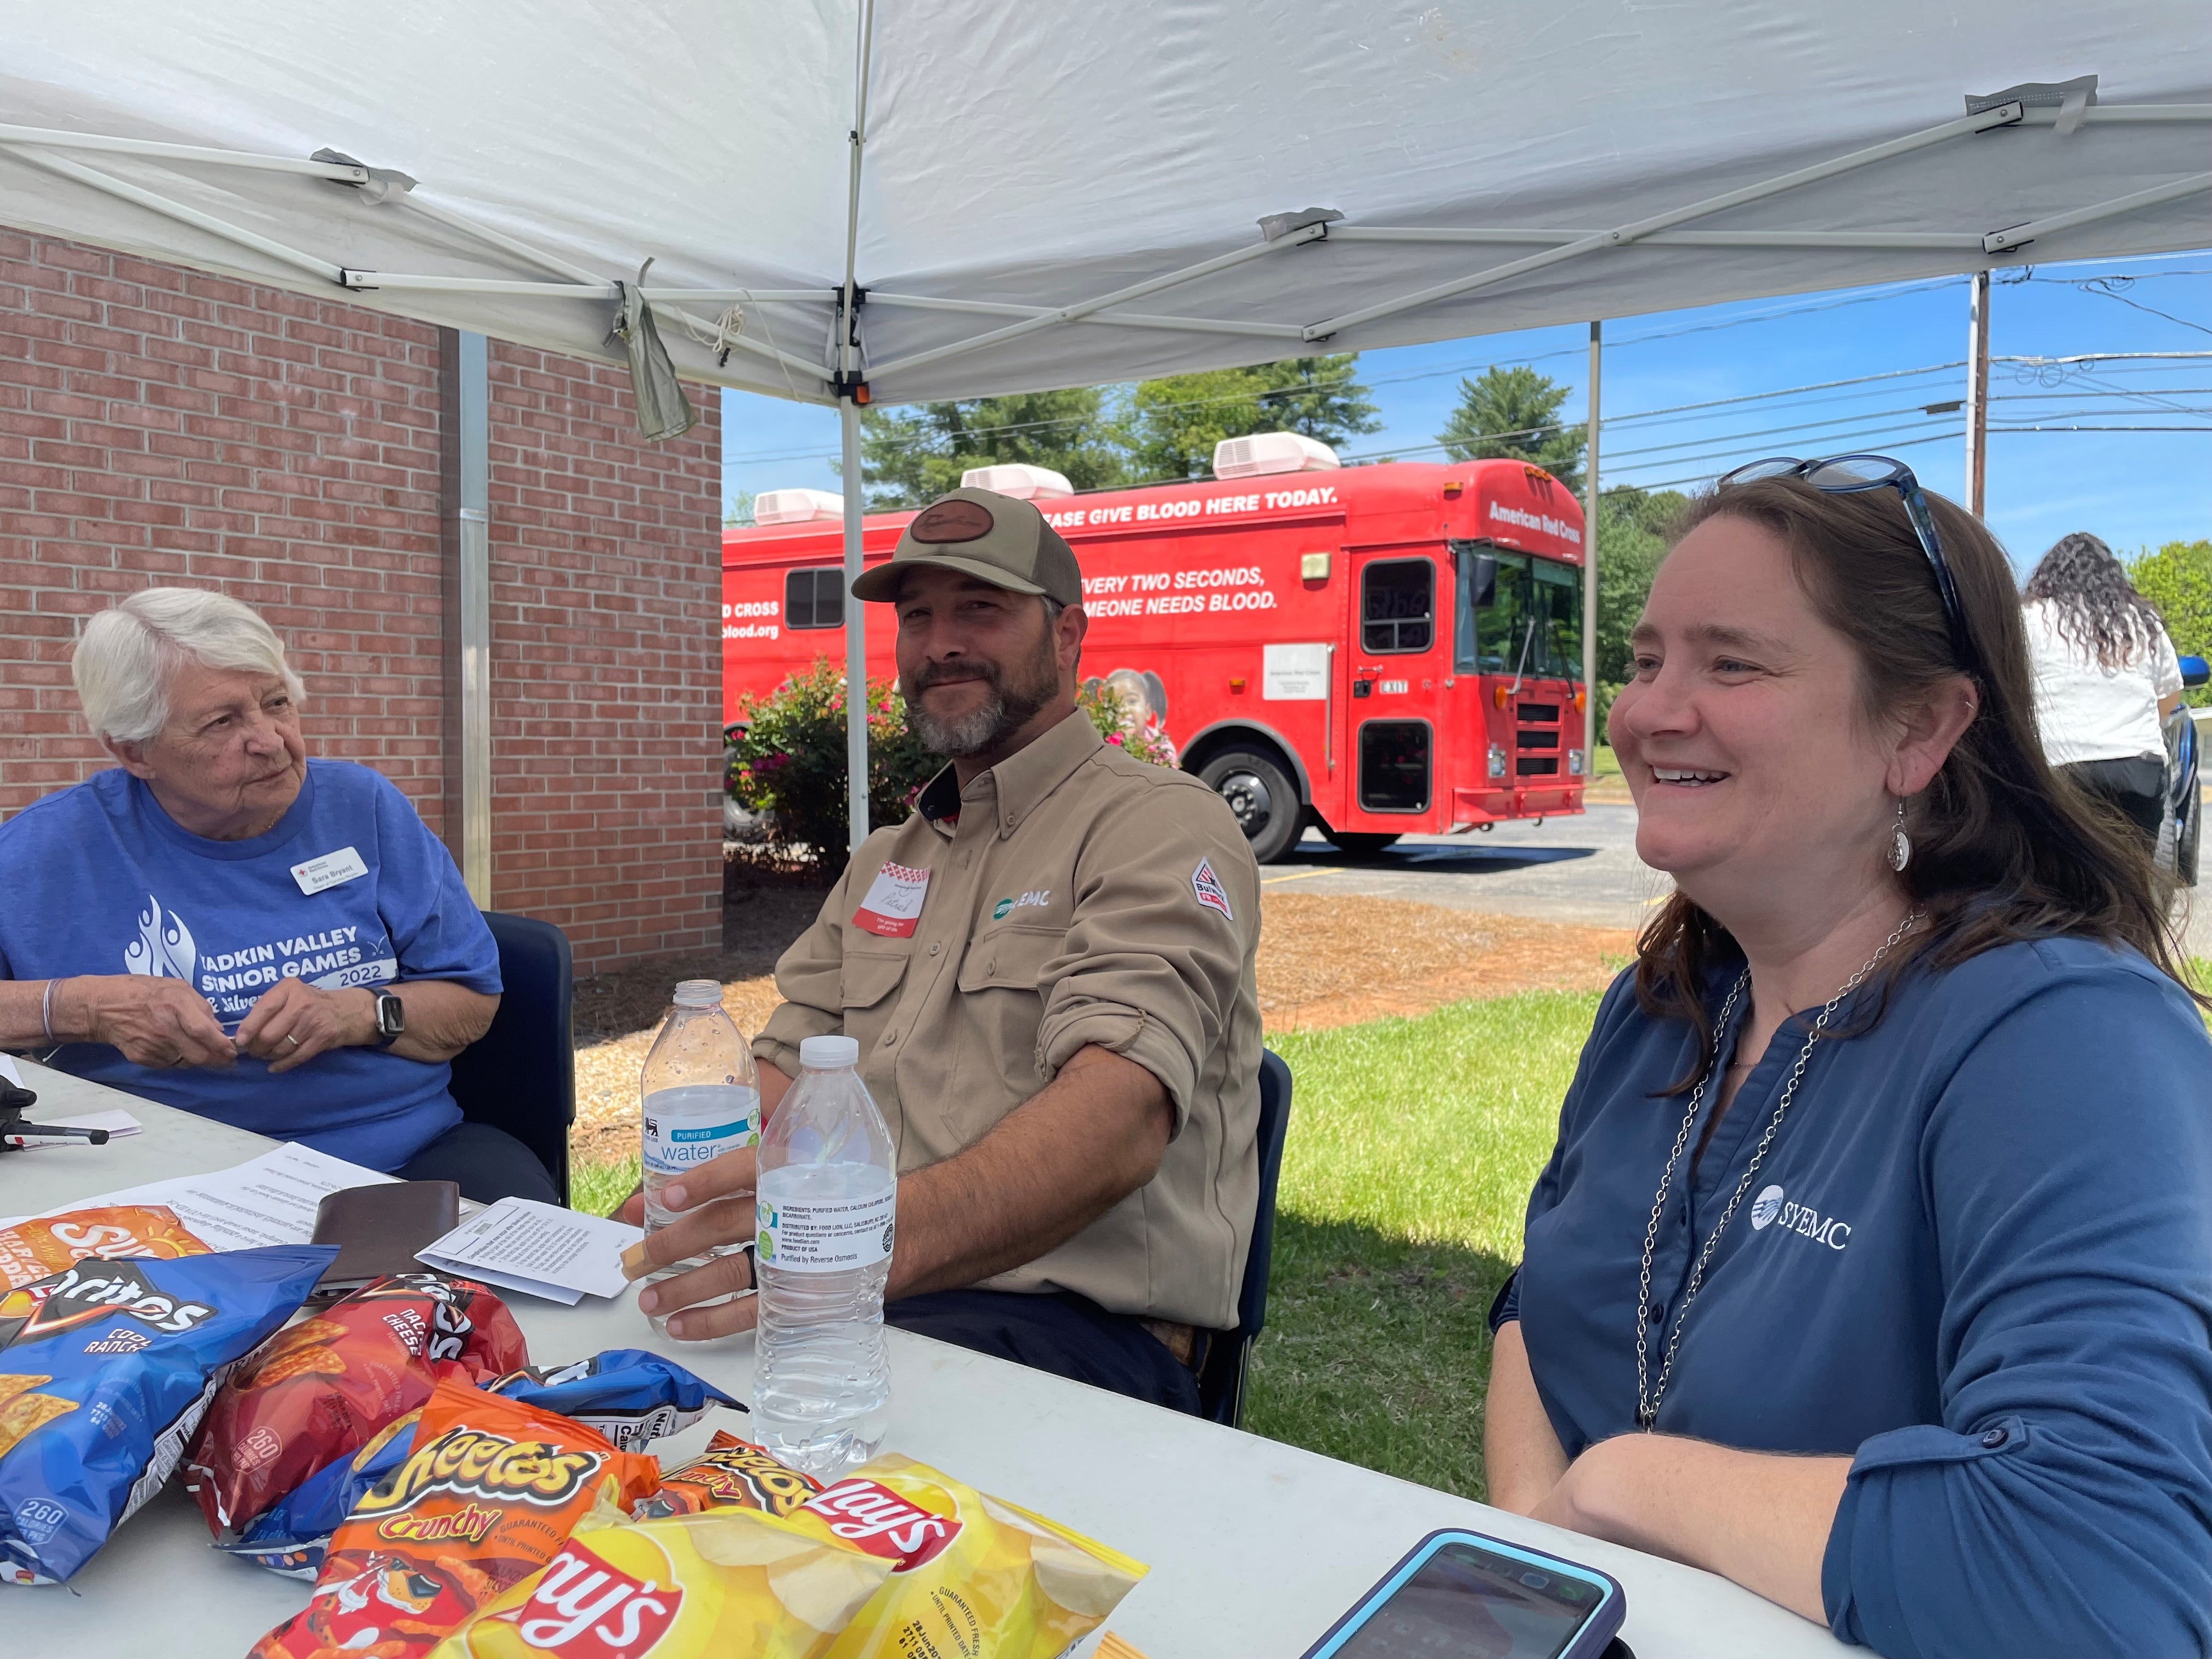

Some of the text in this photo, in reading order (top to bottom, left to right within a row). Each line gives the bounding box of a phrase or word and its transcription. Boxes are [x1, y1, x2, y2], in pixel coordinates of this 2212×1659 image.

[1089, 506, 1133, 525] GIVE
[1137, 500, 1201, 521] BLOOD
[1206, 494, 1261, 516] HERE
[1265, 486, 1338, 510] TODAY.
[1489, 500, 1581, 544] American Red Cross
[1081, 567, 1265, 595] VERY TWO SECONDS,
[735, 601, 779, 618] CROSS
[1083, 591, 1277, 618] MEONE NEEDS BLOOD.
[1381, 681, 1407, 694] EXIT
[312, 875, 329, 884] Sara
[329, 865, 353, 878] Bryant
[276, 926, 357, 957] VALLEY
[281, 947, 362, 977] GAMES
[339, 965, 382, 987] 2022
[677, 1131, 711, 1140] PURIFIED
[661, 1144, 716, 1161] water
[850, 1203, 867, 1211] CALCIUM
[1778, 1200, 1852, 1250] SYEMC
[781, 1253, 801, 1262] Purified
[802, 1256, 809, 1265] by
[834, 1253, 857, 1262] Osmosis
[51, 1269, 210, 1330] oritos
[108, 1328, 153, 1346] COOL
[238, 1442, 261, 1466] CALORIES
[246, 1428, 279, 1459] 260
[16, 1516, 54, 1534] CALORIES
[21, 1501, 63, 1525] 260
[379, 1503, 503, 1541] Crunchy
[802, 1481, 945, 1553] Lay's
[500, 1519, 556, 1538] GUARANTEED
[498, 1536, 516, 1546] UNTIL
[516, 1541, 546, 1560] PRINTED
[521, 1551, 667, 1648] ay's
[932, 1594, 970, 1658] UNTIL PRINTED DATE
[939, 1586, 980, 1656] GUARANTEED FRESH
